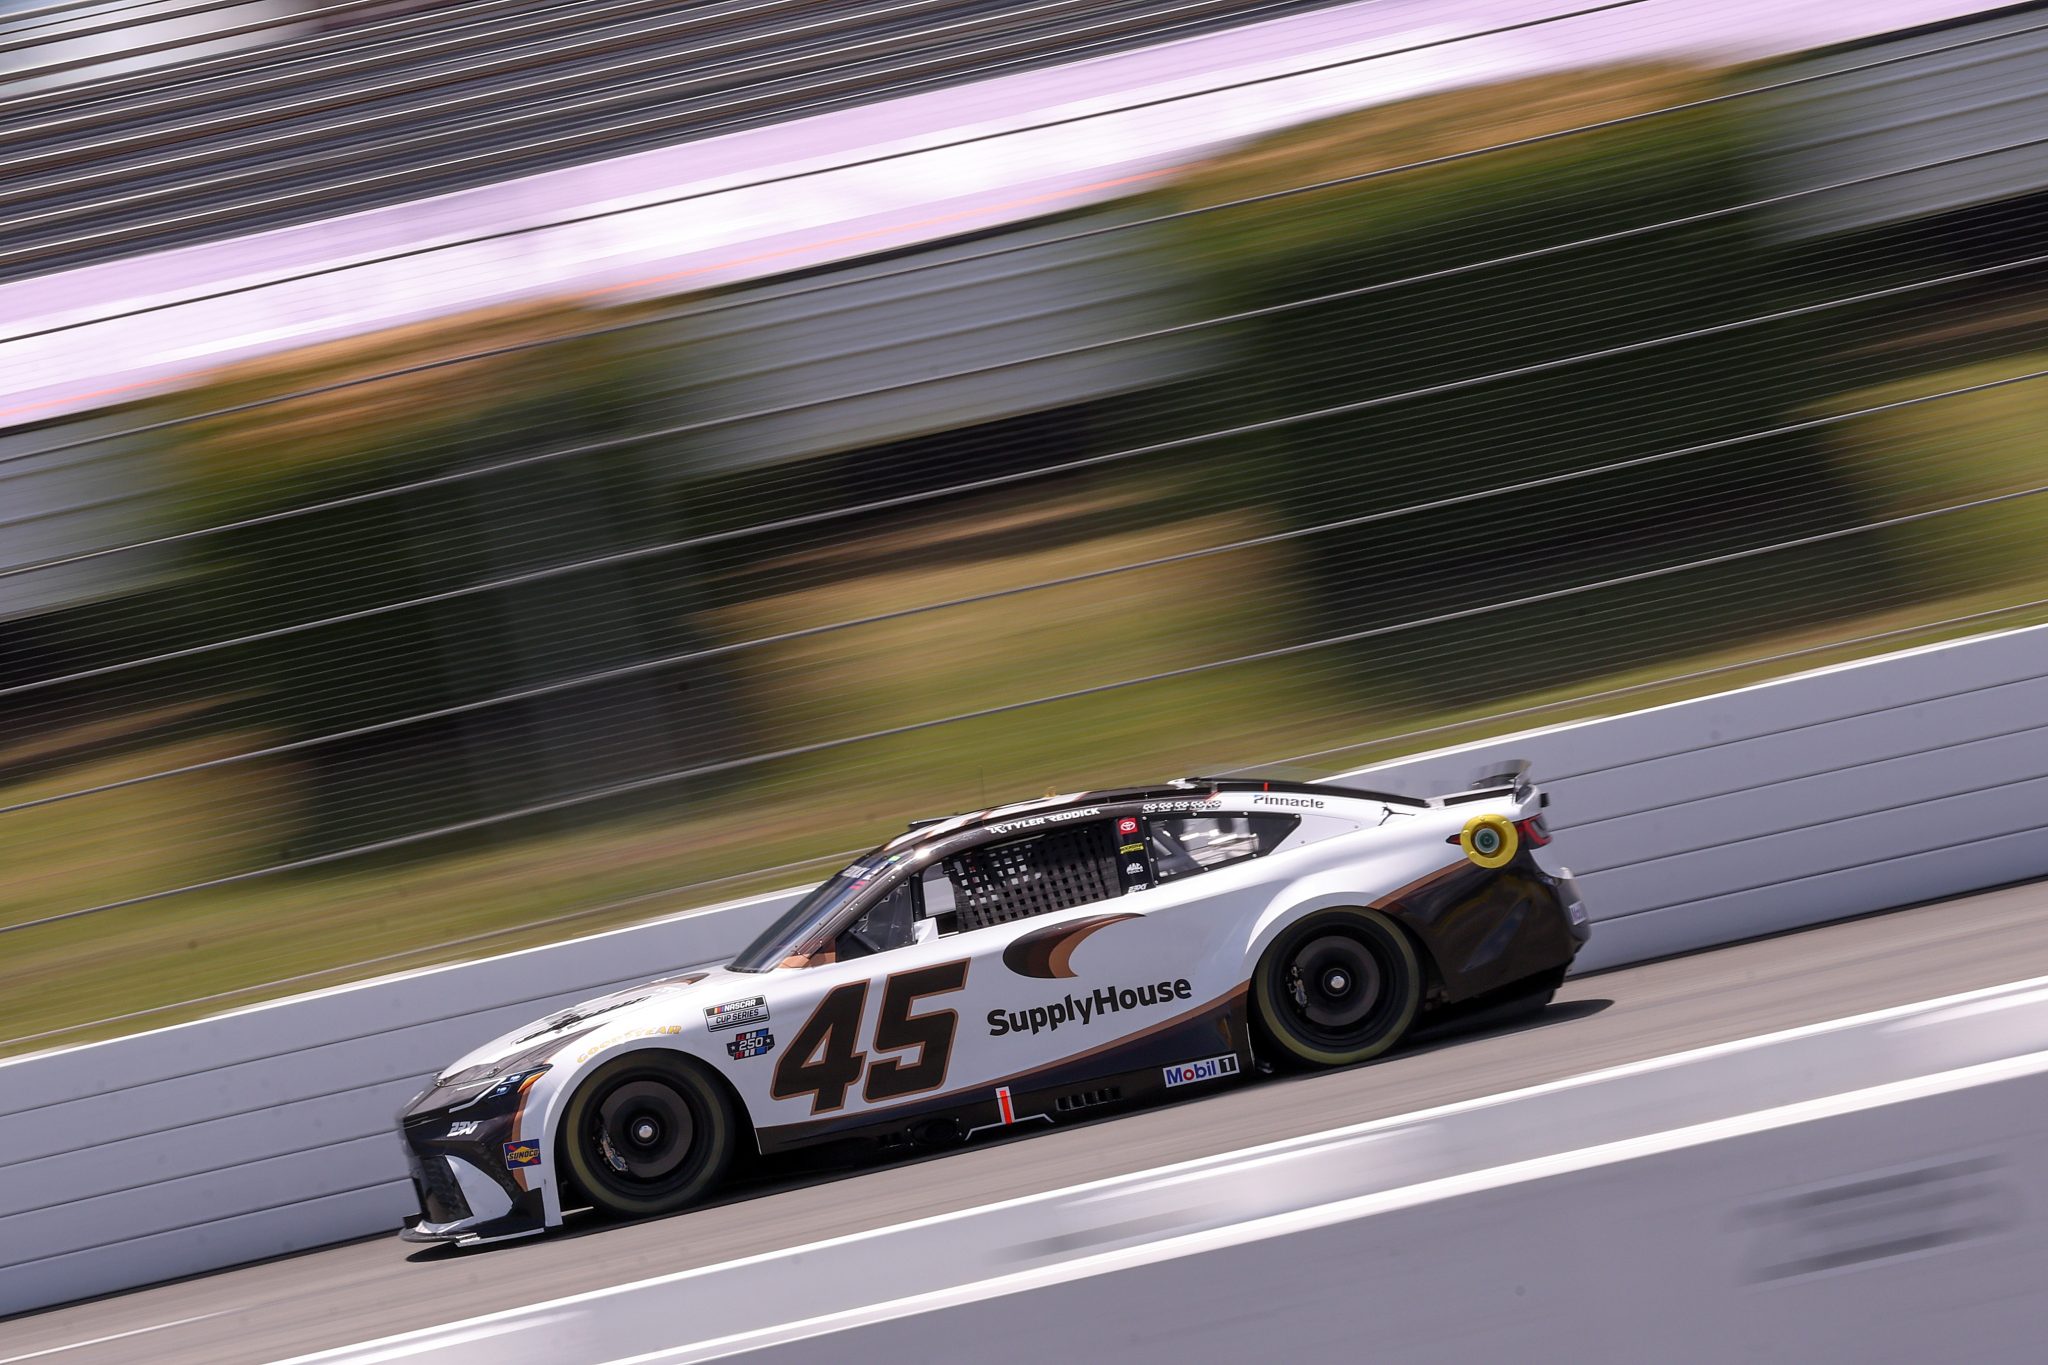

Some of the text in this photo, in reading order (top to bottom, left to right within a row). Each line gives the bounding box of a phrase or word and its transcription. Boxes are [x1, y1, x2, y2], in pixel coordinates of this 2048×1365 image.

[1253, 794, 1325, 809] Pinnacle
[1005, 817, 1046, 832] TYLER
[1045, 807, 1101, 823] REDDICK
[723, 999, 757, 1013] NASCAR
[986, 979, 1192, 1036] SupplyHouse
[716, 1008, 760, 1024] CUP SERIES
[739, 1037, 764, 1051] 250
[770, 957, 971, 1115] 45
[1166, 1058, 1232, 1085] Mobil 1
[509, 1149, 540, 1160] SUNOCO
